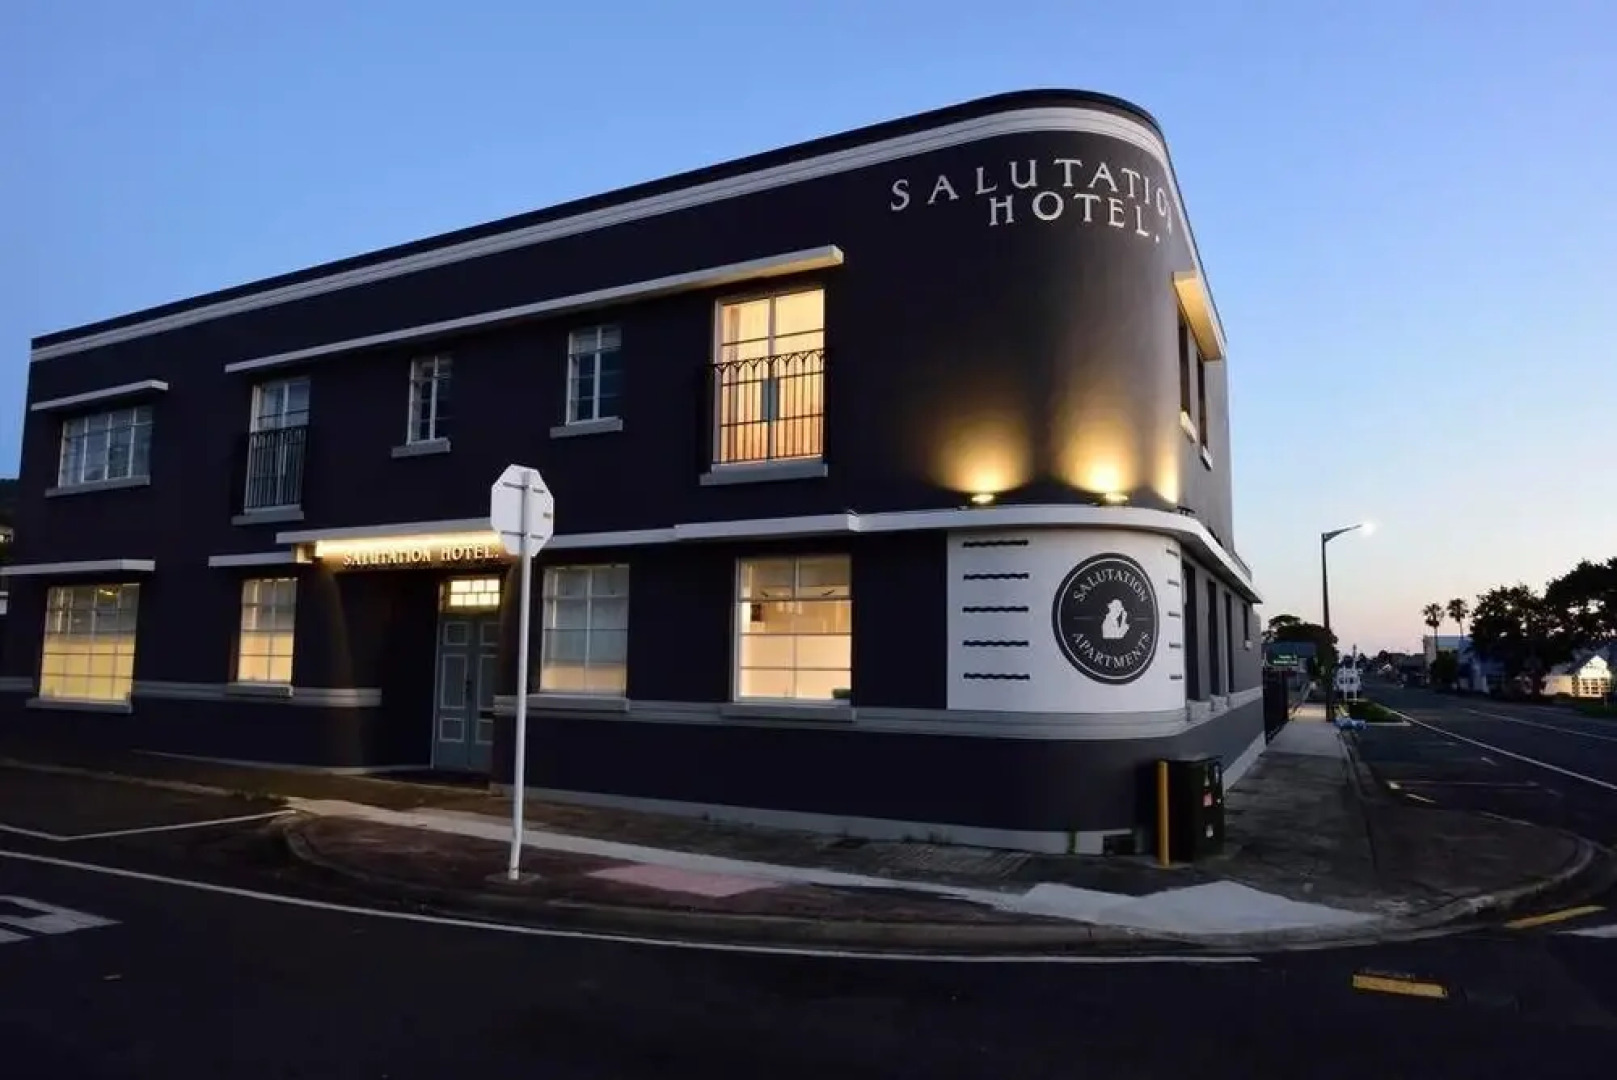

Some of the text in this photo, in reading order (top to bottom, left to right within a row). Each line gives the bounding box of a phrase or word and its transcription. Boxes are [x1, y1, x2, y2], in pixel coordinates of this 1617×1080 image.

[988, 191, 1160, 243] HOTEL.
[343, 548, 431, 565] SALUTATION
[1073, 568, 1149, 602] SALUTATION
[1072, 631, 1151, 669] APARTMENTS
